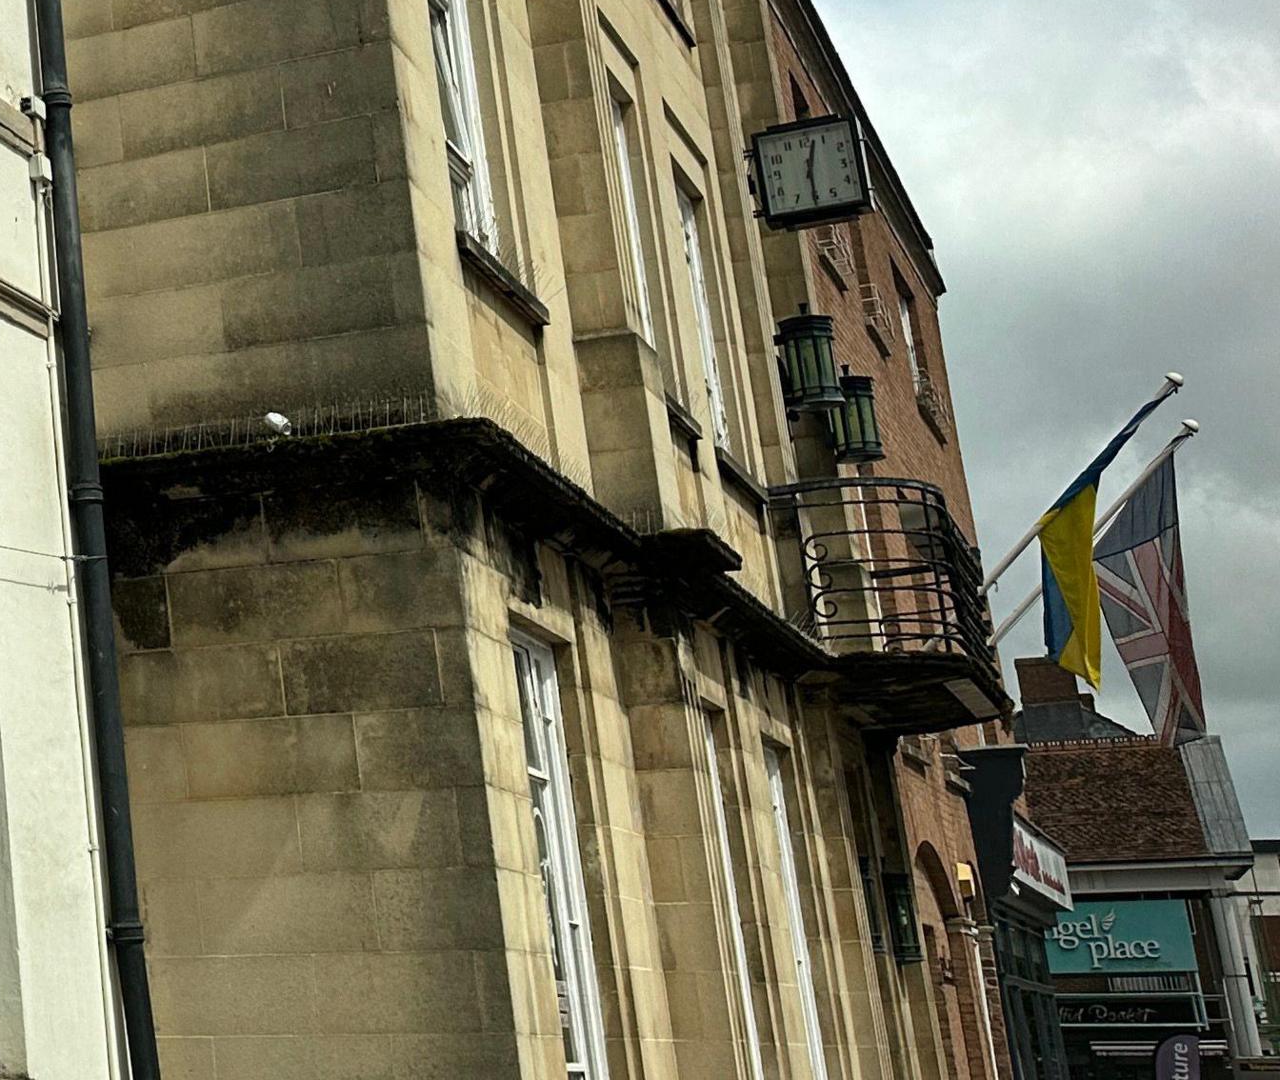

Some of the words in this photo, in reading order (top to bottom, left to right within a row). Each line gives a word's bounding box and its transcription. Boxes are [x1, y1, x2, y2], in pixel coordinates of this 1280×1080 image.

[784, 141, 792, 151] 11
[799, 137, 810, 149] 12
[836, 142, 845, 152] 2
[771, 155, 783, 165] 10
[840, 158, 848, 168] 3
[773, 170, 781, 180] 9
[843, 175, 851, 185] 4
[829, 188, 838, 198] 5
[793, 194, 800, 204] 7
[1088, 934, 1161, 969] place
